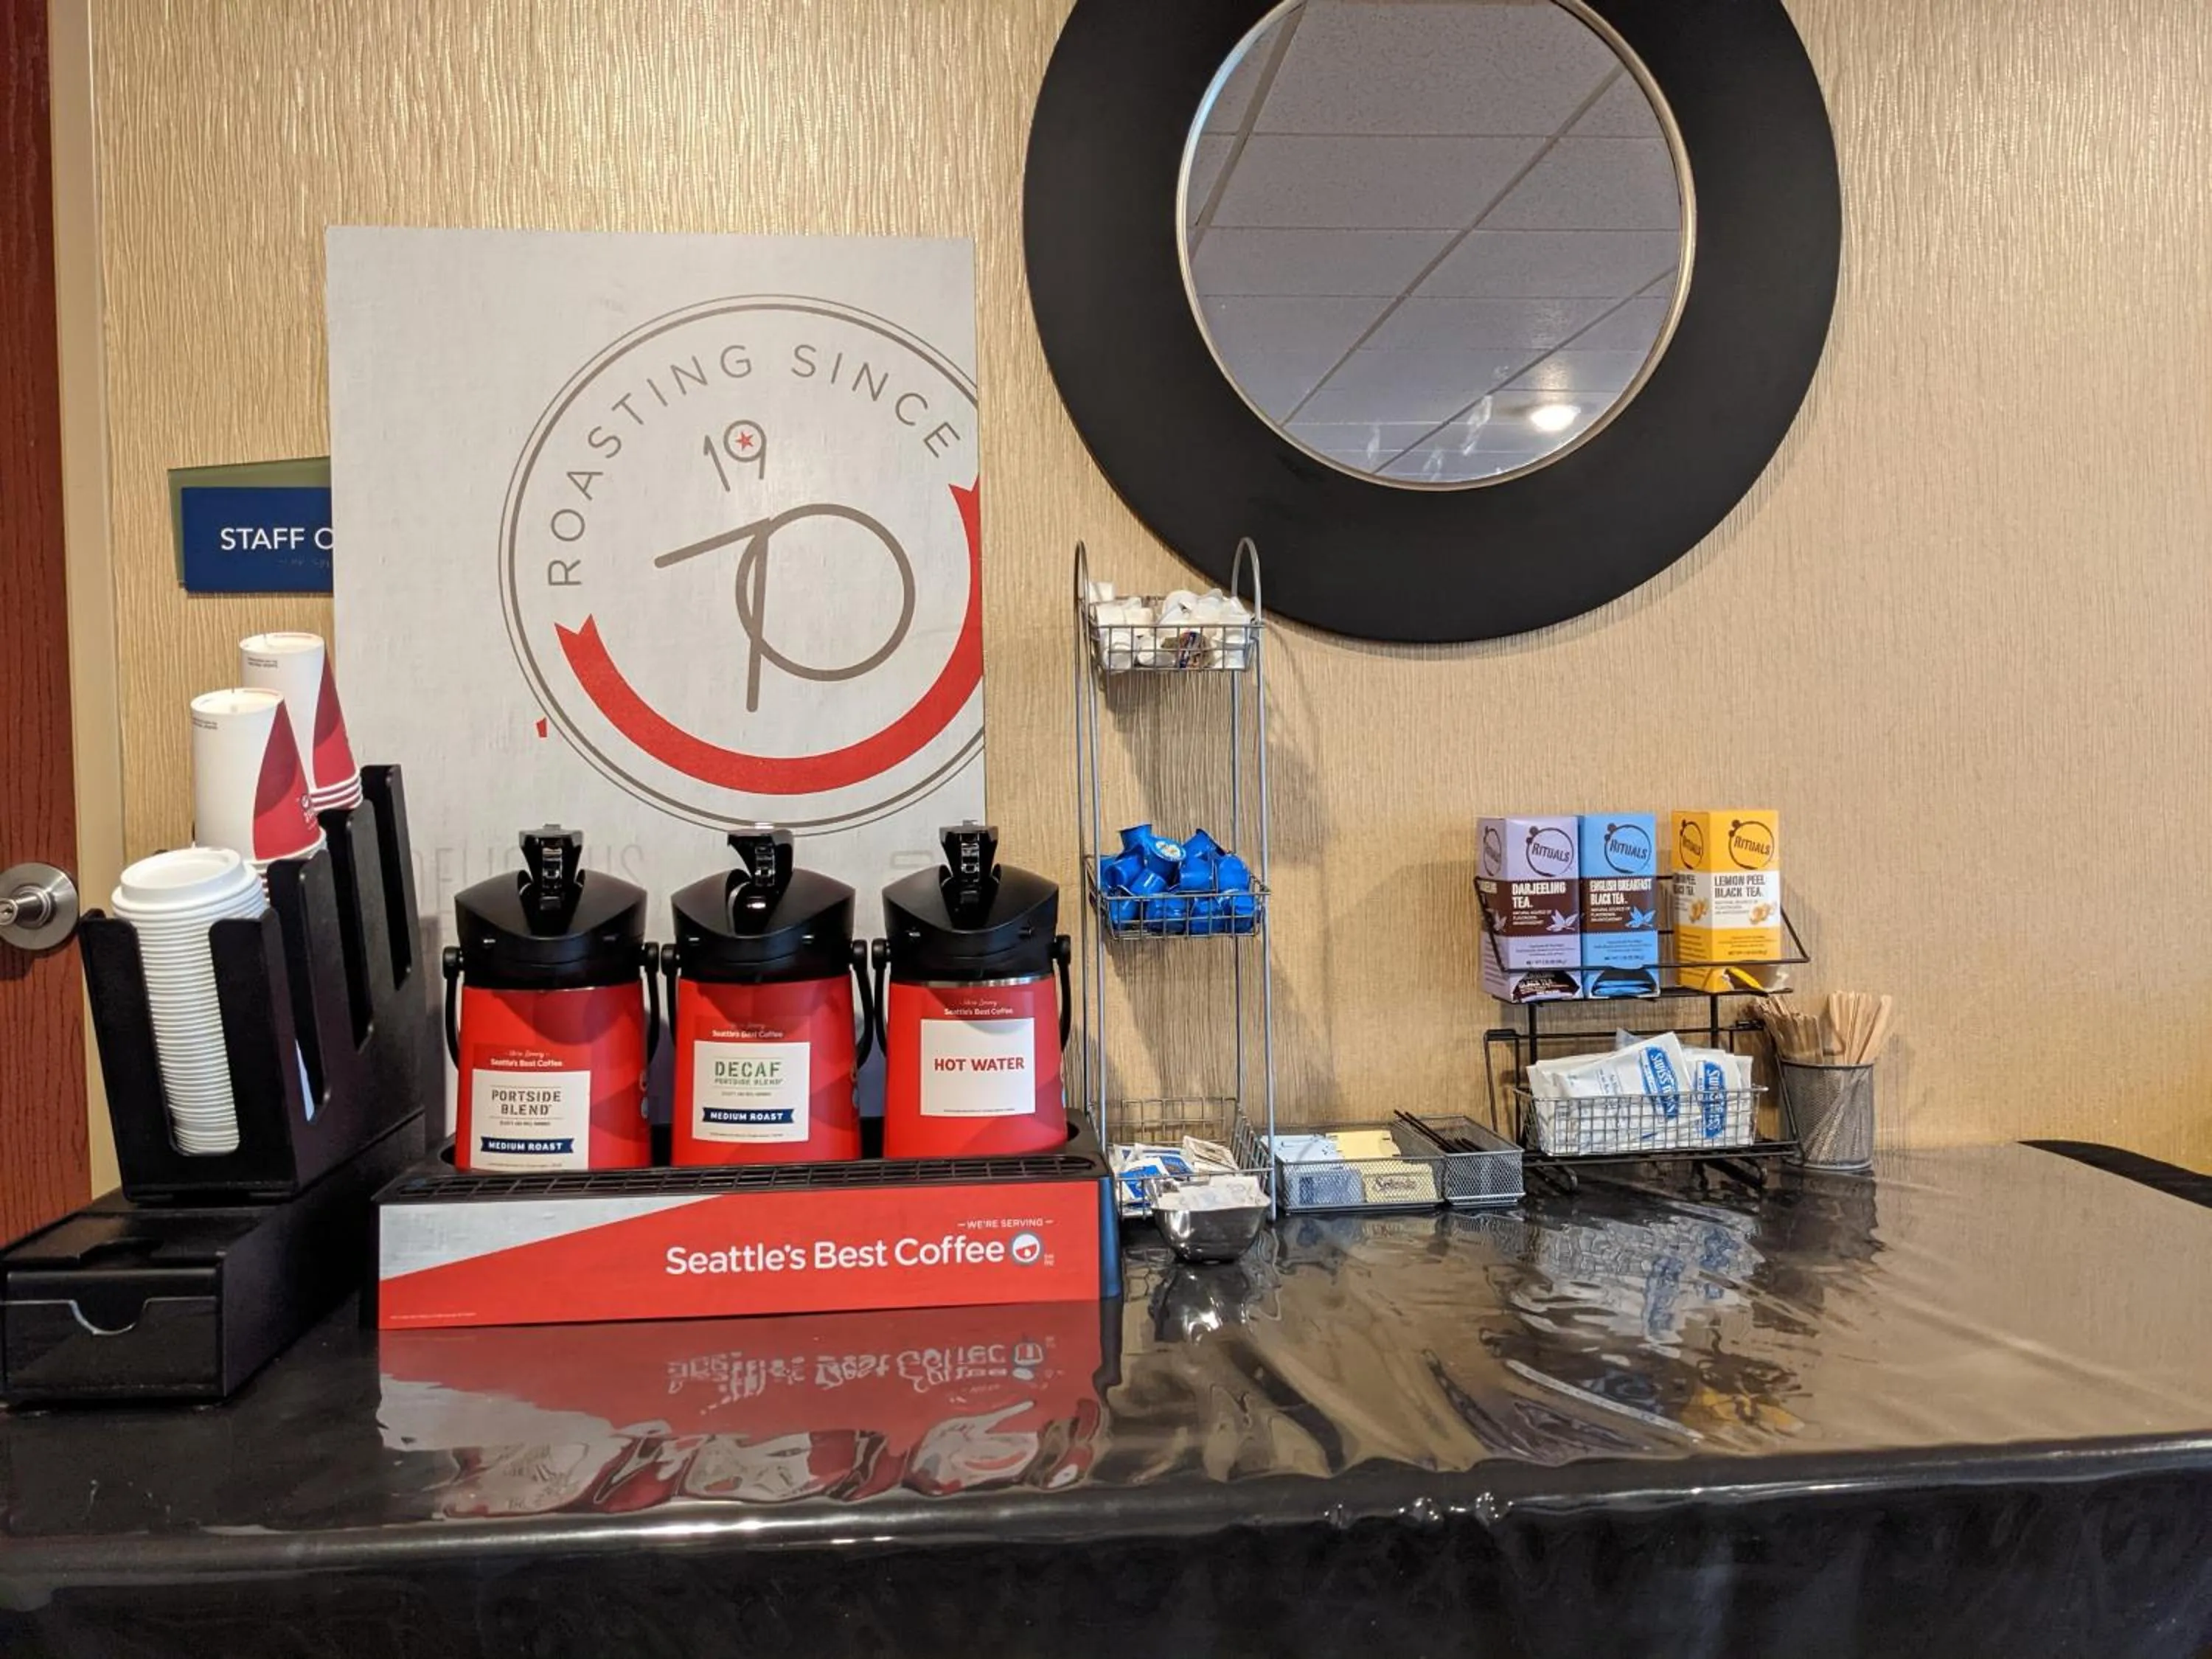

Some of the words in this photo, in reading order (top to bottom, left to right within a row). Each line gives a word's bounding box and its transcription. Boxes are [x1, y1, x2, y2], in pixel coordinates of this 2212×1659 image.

[703, 420, 767, 493] 19
[548, 344, 752, 587] ROASTING
[790, 344, 961, 459] SINCE
[220, 527, 305, 550] STAFF
[654, 504, 916, 713] 70
[1531, 843, 1571, 862] RITUALS
[1610, 839, 1647, 859] RITUALS
[1734, 836, 1770, 855] RITUALS
[1714, 875, 1745, 886] LEMON
[1746, 874, 1765, 885] PEEL
[1512, 881, 1567, 895] DARJEELING
[1714, 887, 1742, 897] BLACK
[1590, 893, 1611, 905] BLACK
[991, 1007, 1013, 1015] Coffee
[537, 1059, 563, 1067] Coffee
[714, 1060, 782, 1077] DECAF
[934, 1058, 966, 1071] HOT
[971, 1057, 1025, 1071] WATER
[492, 1089, 562, 1103] PORTSIDE
[710, 1112, 747, 1121] MEDIUM
[749, 1113, 784, 1121] ROAST
[488, 1141, 526, 1151] MEDIUM
[527, 1142, 563, 1151] ROAST
[967, 1220, 999, 1229] WE'RE
[1001, 1218, 1043, 1228] SERVING
[666, 1242, 806, 1275] Seattle's
[814, 1238, 888, 1269] Best
[894, 1234, 1005, 1266] Coffee
